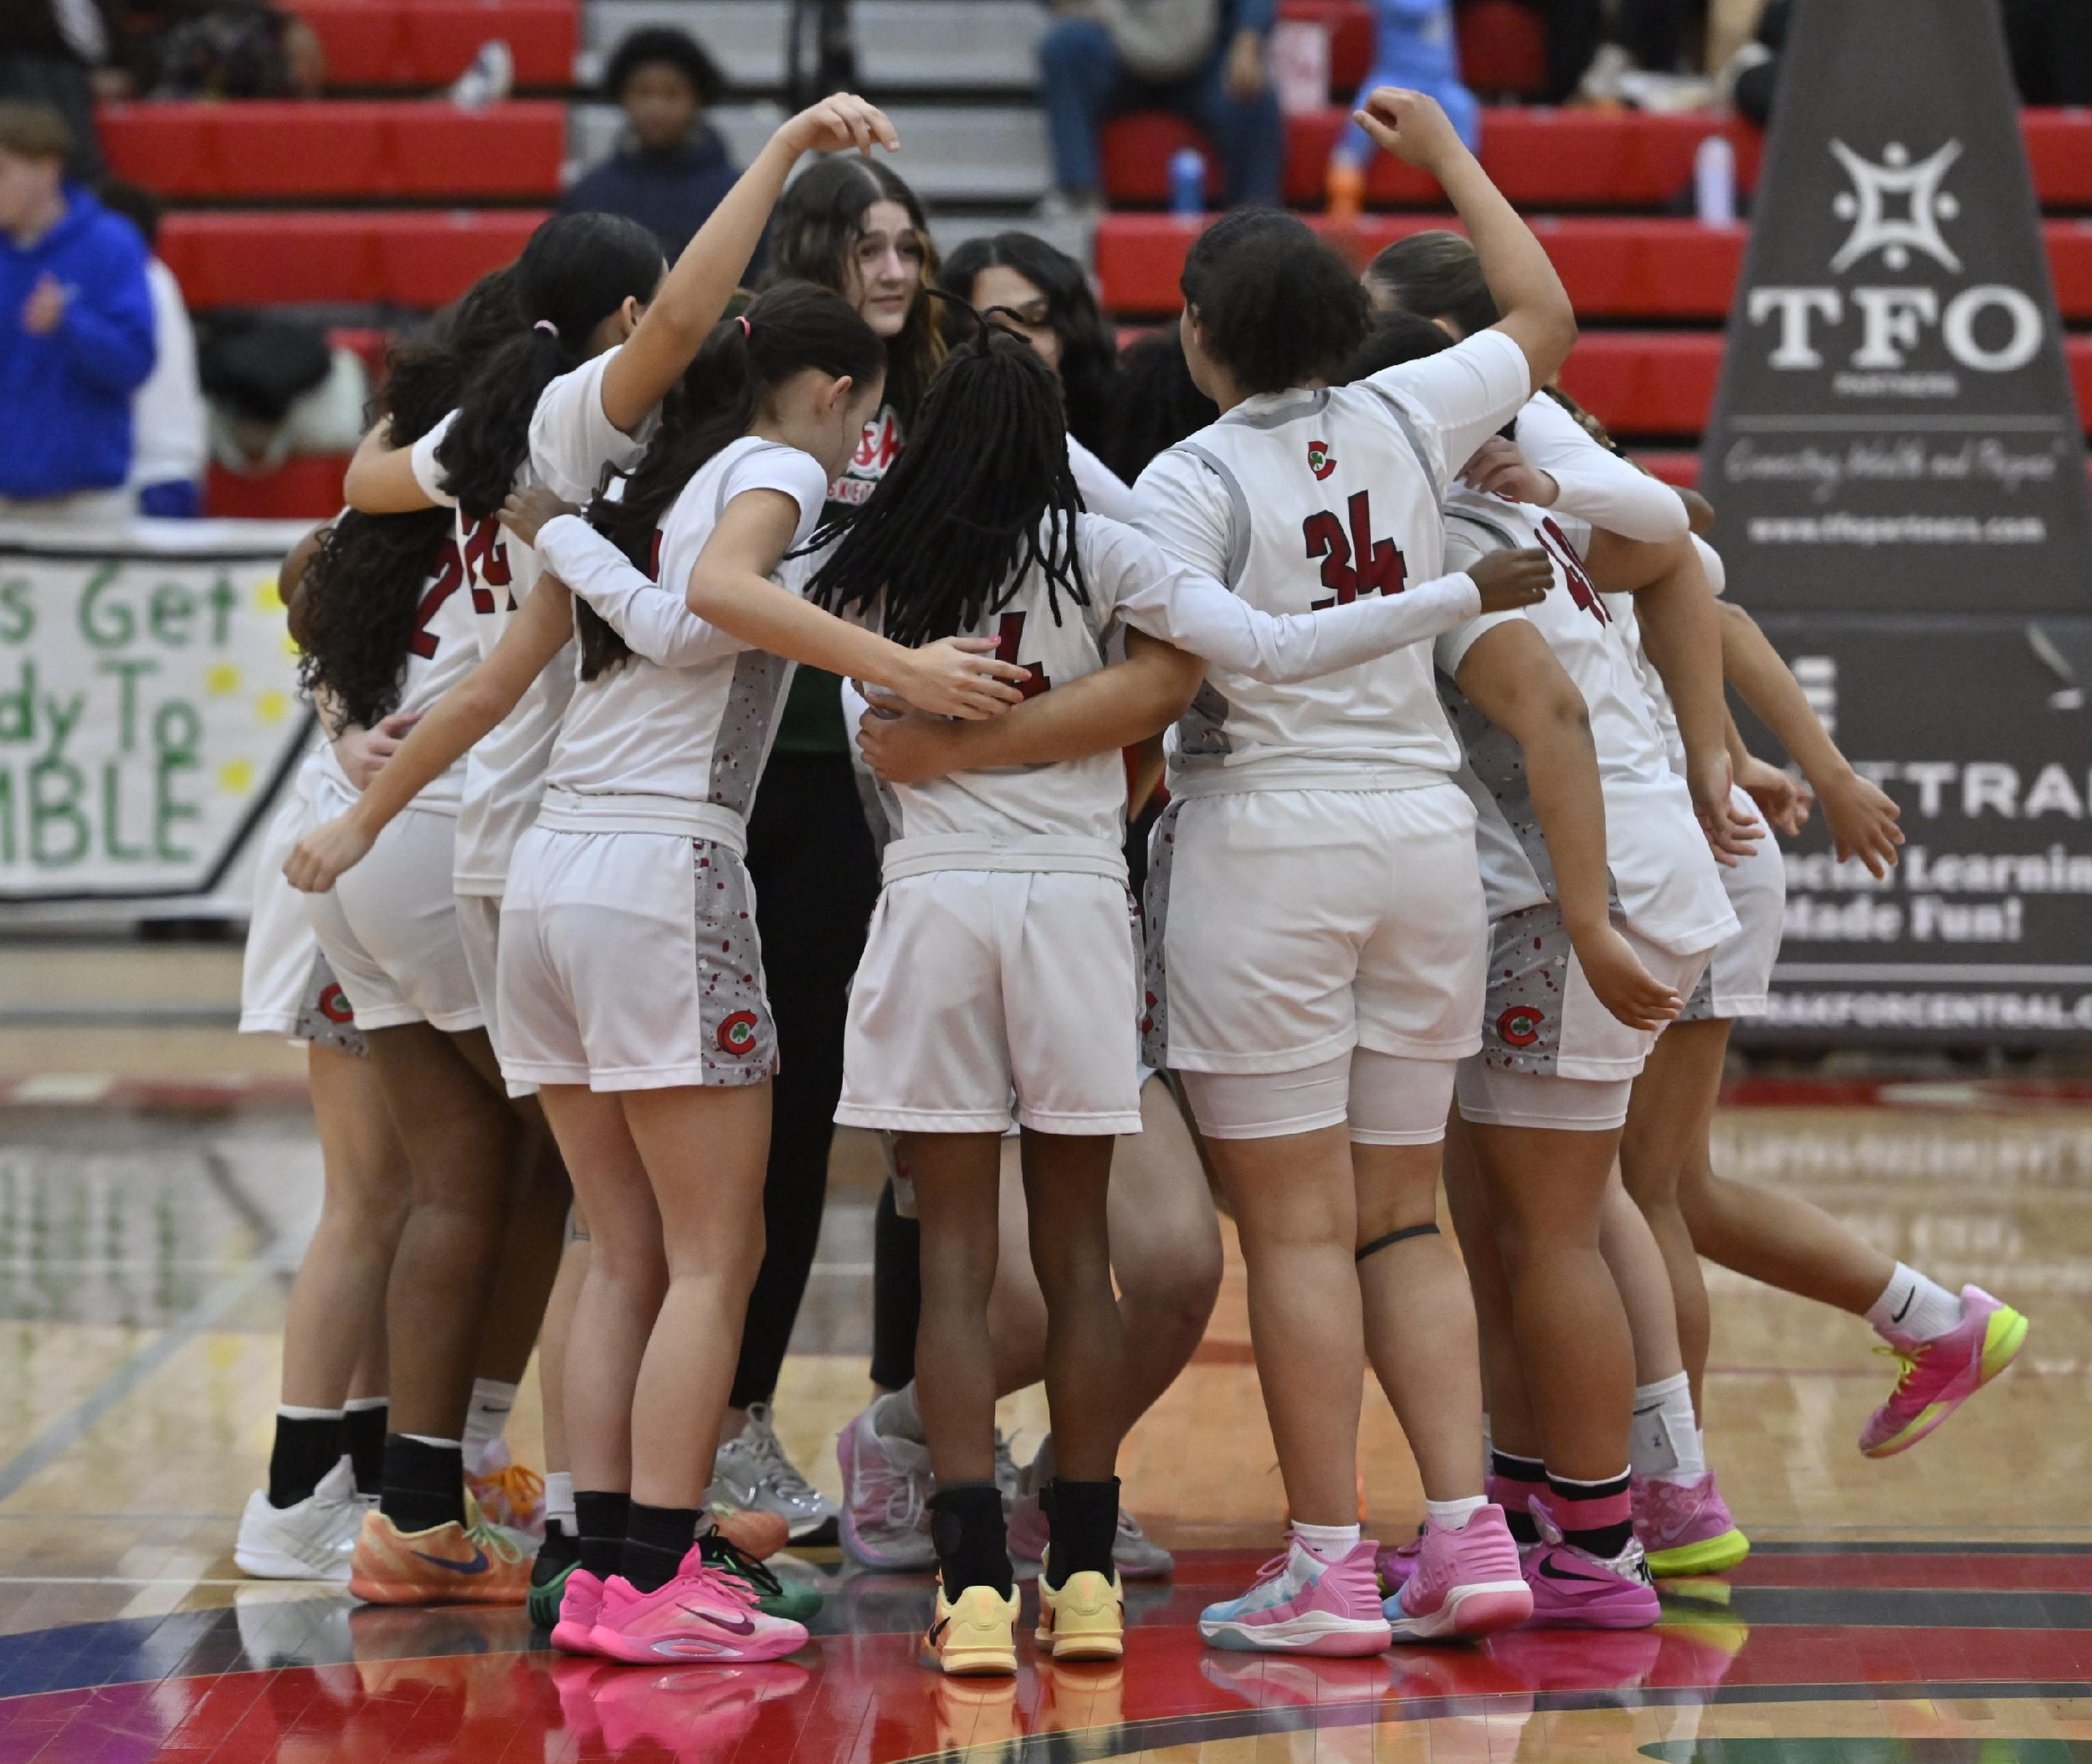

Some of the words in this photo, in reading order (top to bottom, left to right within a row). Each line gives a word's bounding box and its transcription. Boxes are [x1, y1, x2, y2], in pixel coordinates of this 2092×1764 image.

[1749, 285, 2043, 372] TFO
[1302, 490, 1408, 611] 34
[77, 561, 238, 649] Get
[100, 659, 201, 765] To
[1910, 894, 2023, 943] Fun!
